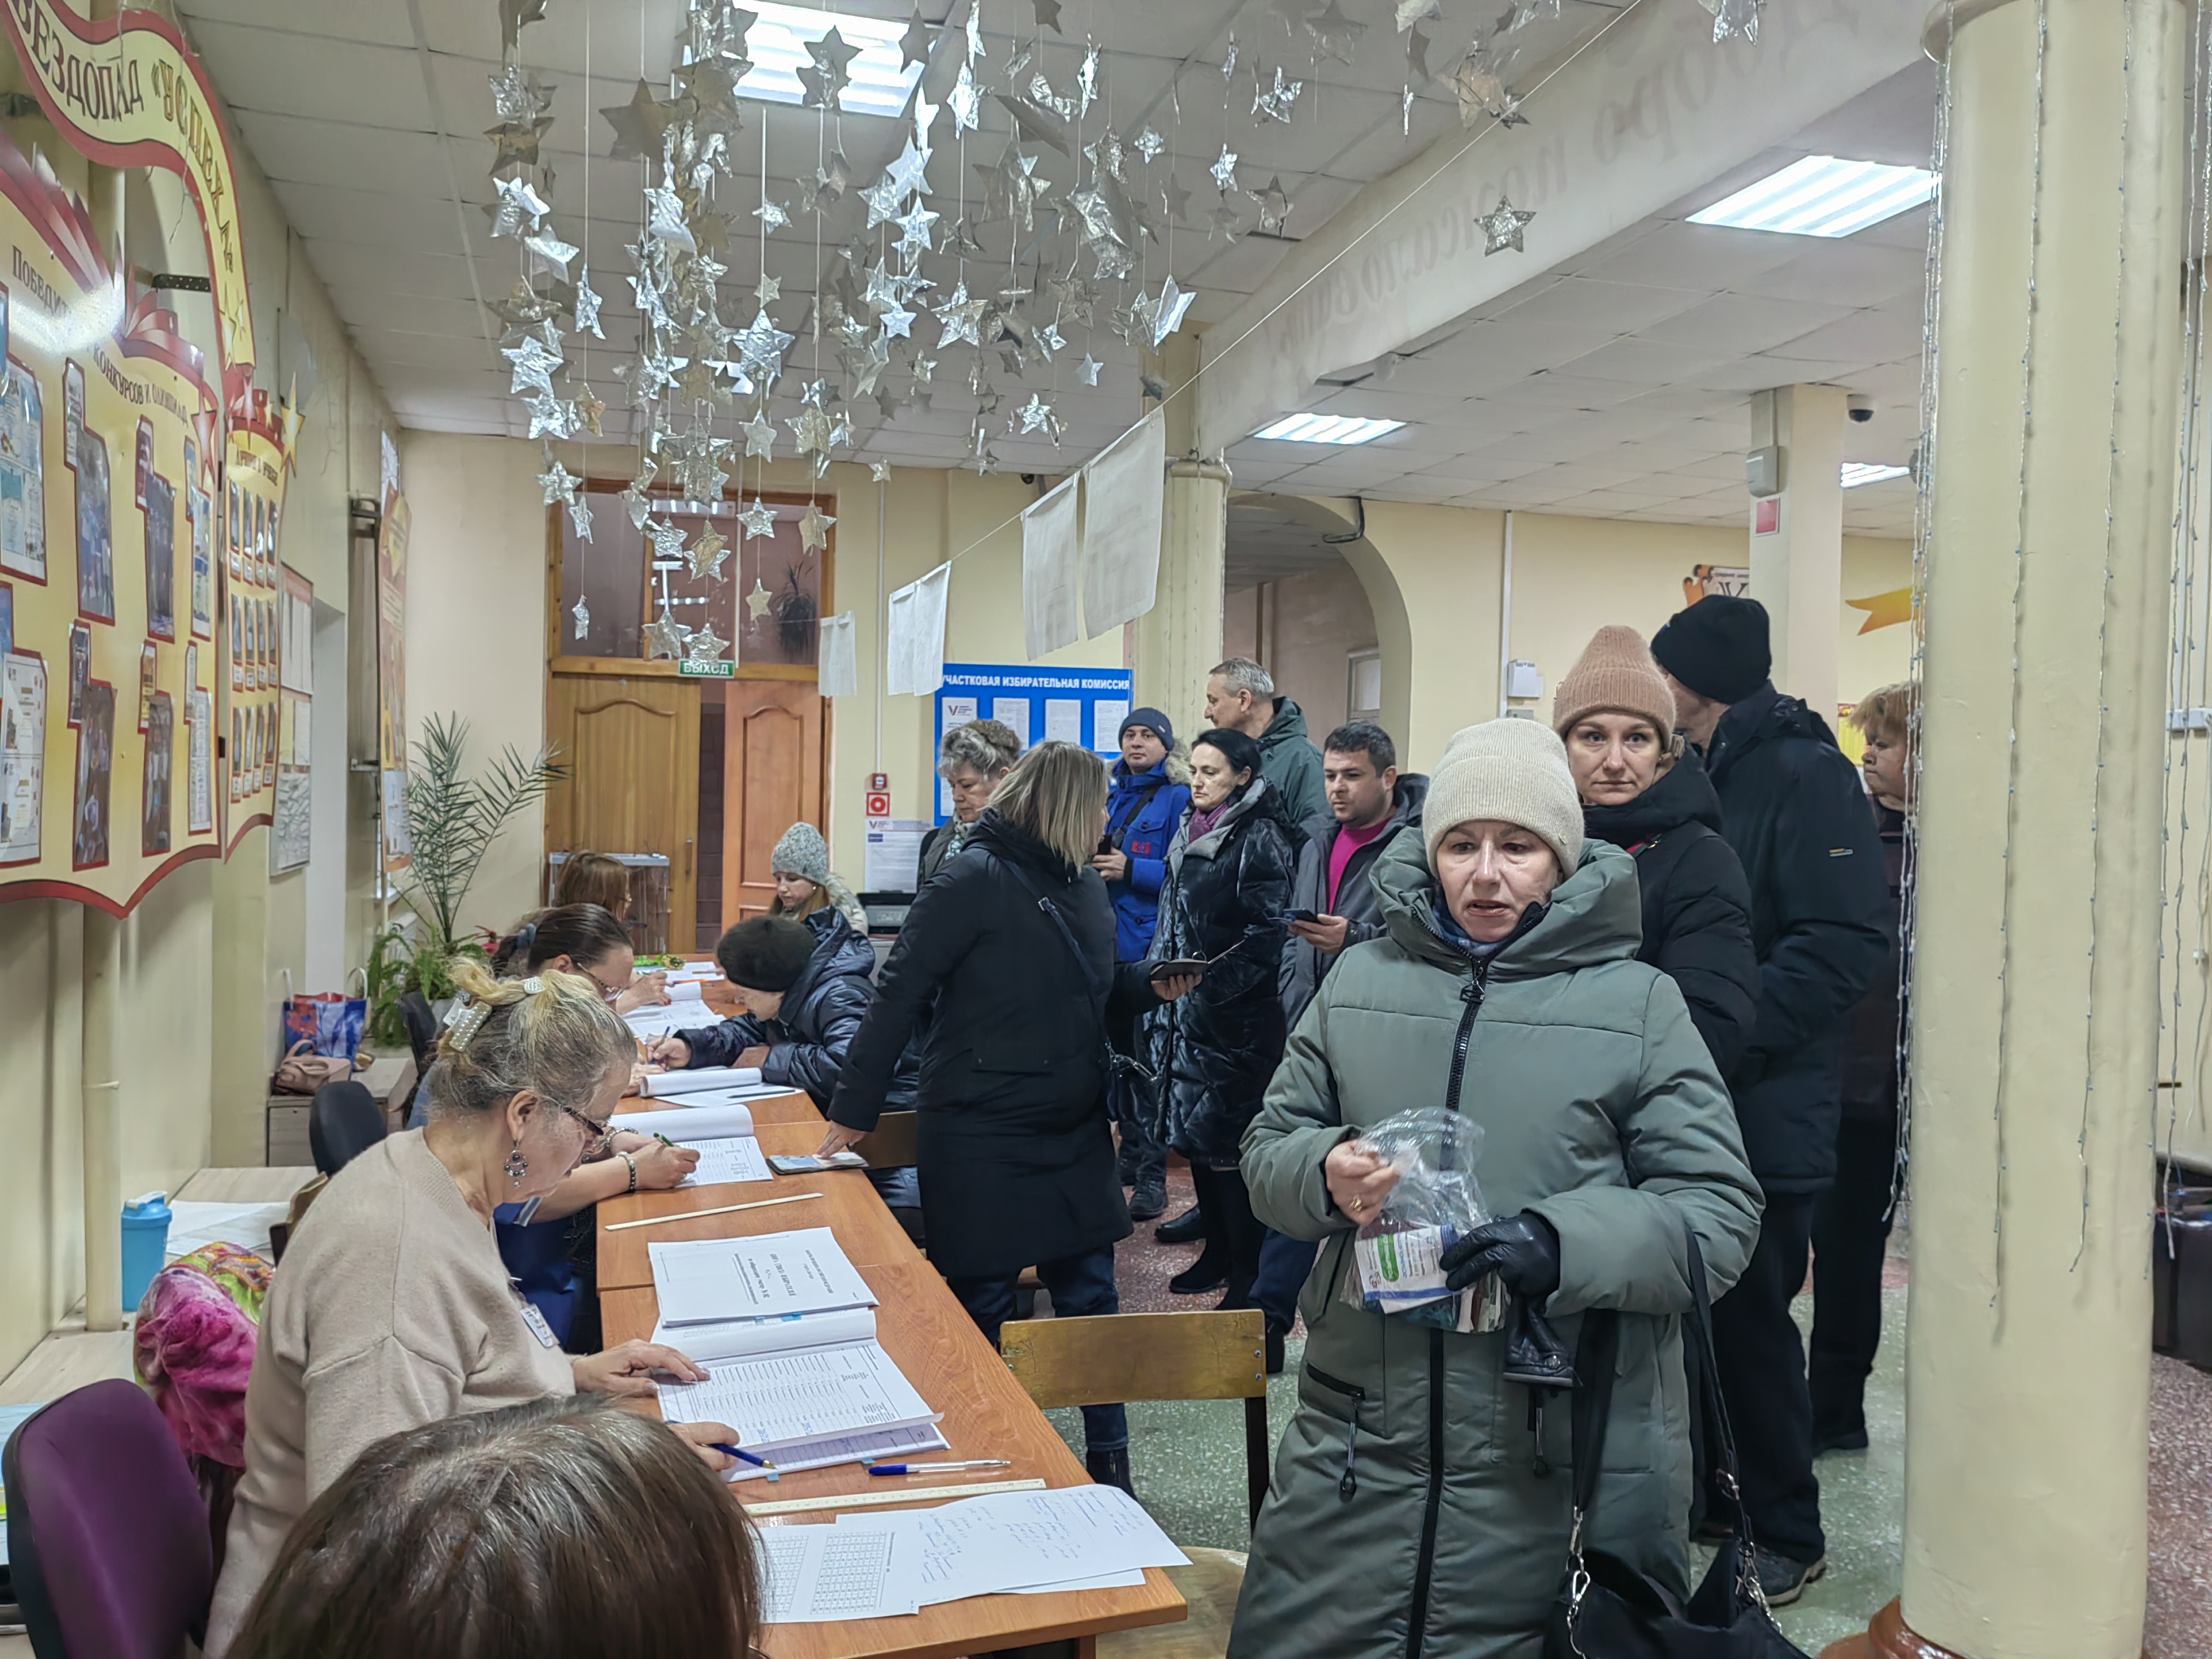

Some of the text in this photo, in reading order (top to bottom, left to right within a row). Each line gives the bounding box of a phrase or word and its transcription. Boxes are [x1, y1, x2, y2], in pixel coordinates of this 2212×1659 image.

[12, 245, 70, 319] ПОБЕДИТ
[684, 663, 729, 675] ВЫХОД
[1002, 677, 1079, 689] ИЗБИРАТЕЛЬНАЯ
[1082, 679, 1129, 690] КОМИССИЯ
